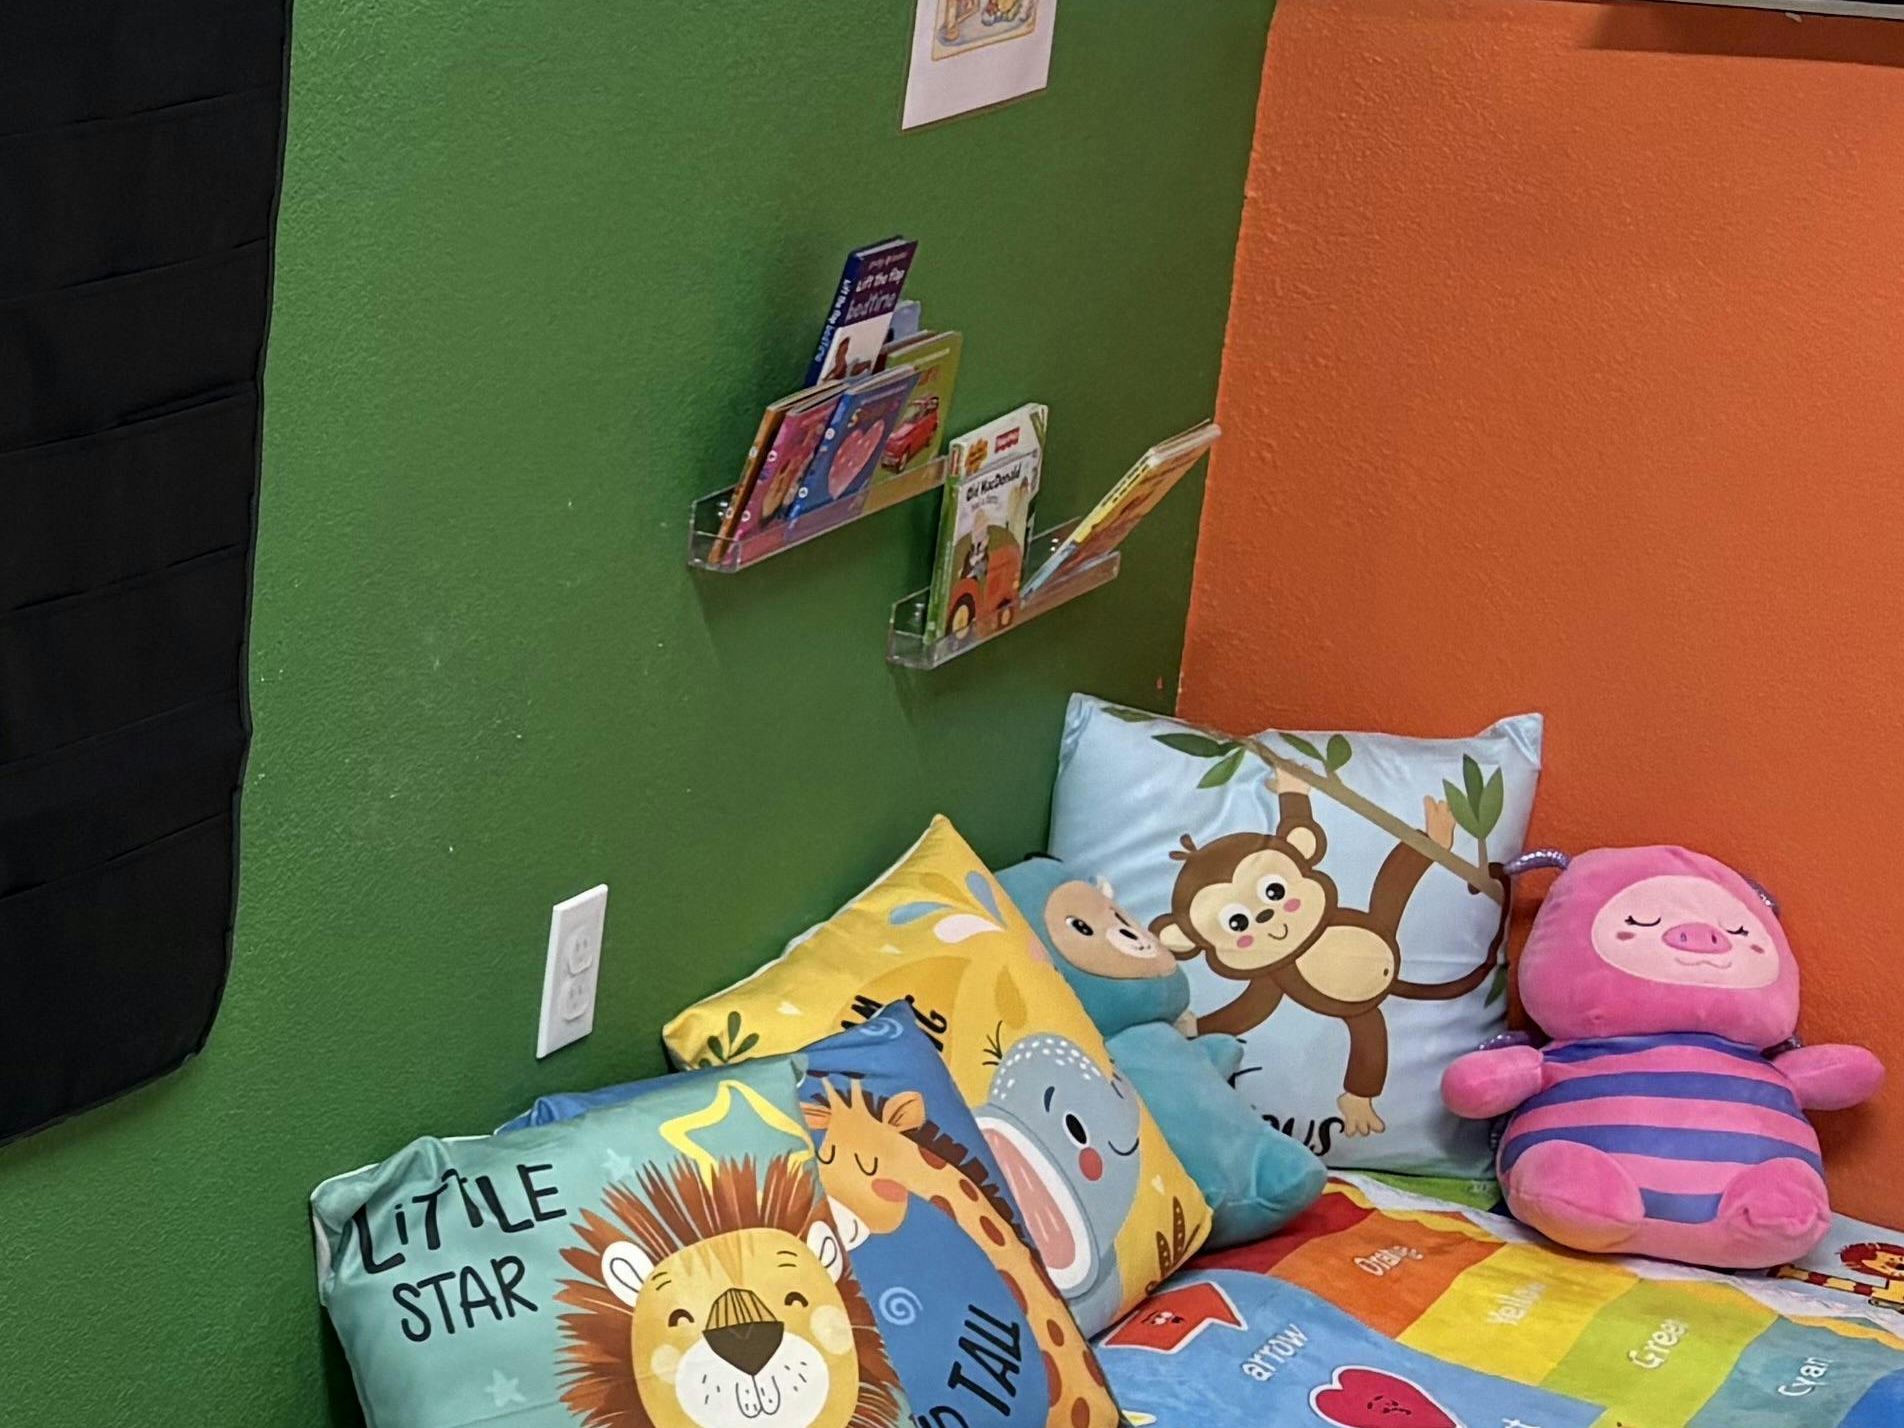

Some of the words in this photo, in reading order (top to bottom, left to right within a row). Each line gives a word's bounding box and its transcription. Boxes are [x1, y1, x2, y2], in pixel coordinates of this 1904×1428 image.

[856, 276, 874, 293] Lift
[874, 273, 889, 286] the
[889, 268, 906, 285] flap
[845, 291, 897, 320] bedtime
[966, 481, 981, 502] Old
[981, 461, 1022, 495] MacDonald
[393, 1254, 539, 1343] STAR
[947, 1303, 1022, 1417] TALL
[1241, 1323, 1310, 1383] arrow
[1778, 1355, 1834, 1400] Cyan
